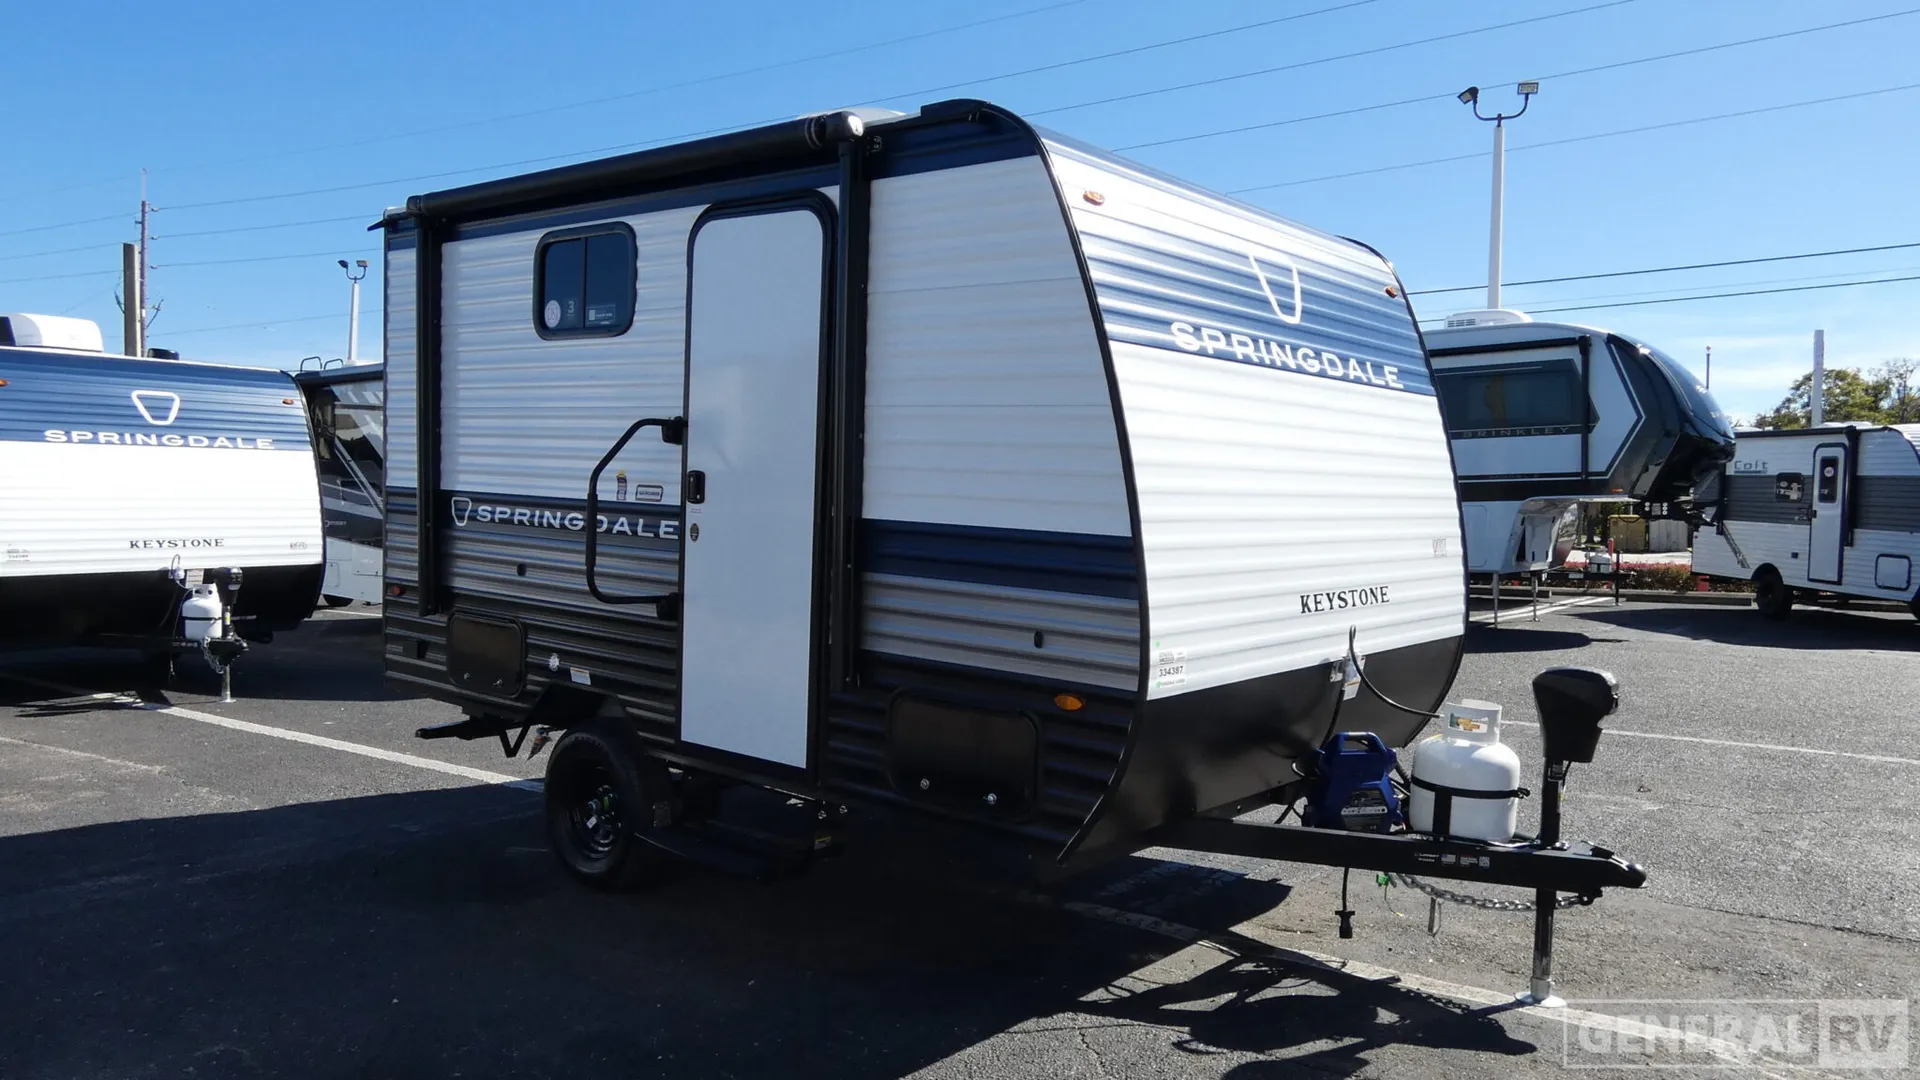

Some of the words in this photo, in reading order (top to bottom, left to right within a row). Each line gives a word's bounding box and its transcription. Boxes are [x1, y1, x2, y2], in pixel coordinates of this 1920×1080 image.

[1170, 321, 1405, 389] SPRINGDALE
[43, 429, 275, 450] SPRINGDALE
[1463, 427, 1570, 438] BRINKLEY
[1734, 460, 1769, 470] Colt
[129, 538, 225, 549] KEYSTONE
[1300, 586, 1390, 614] KEYSTONE
